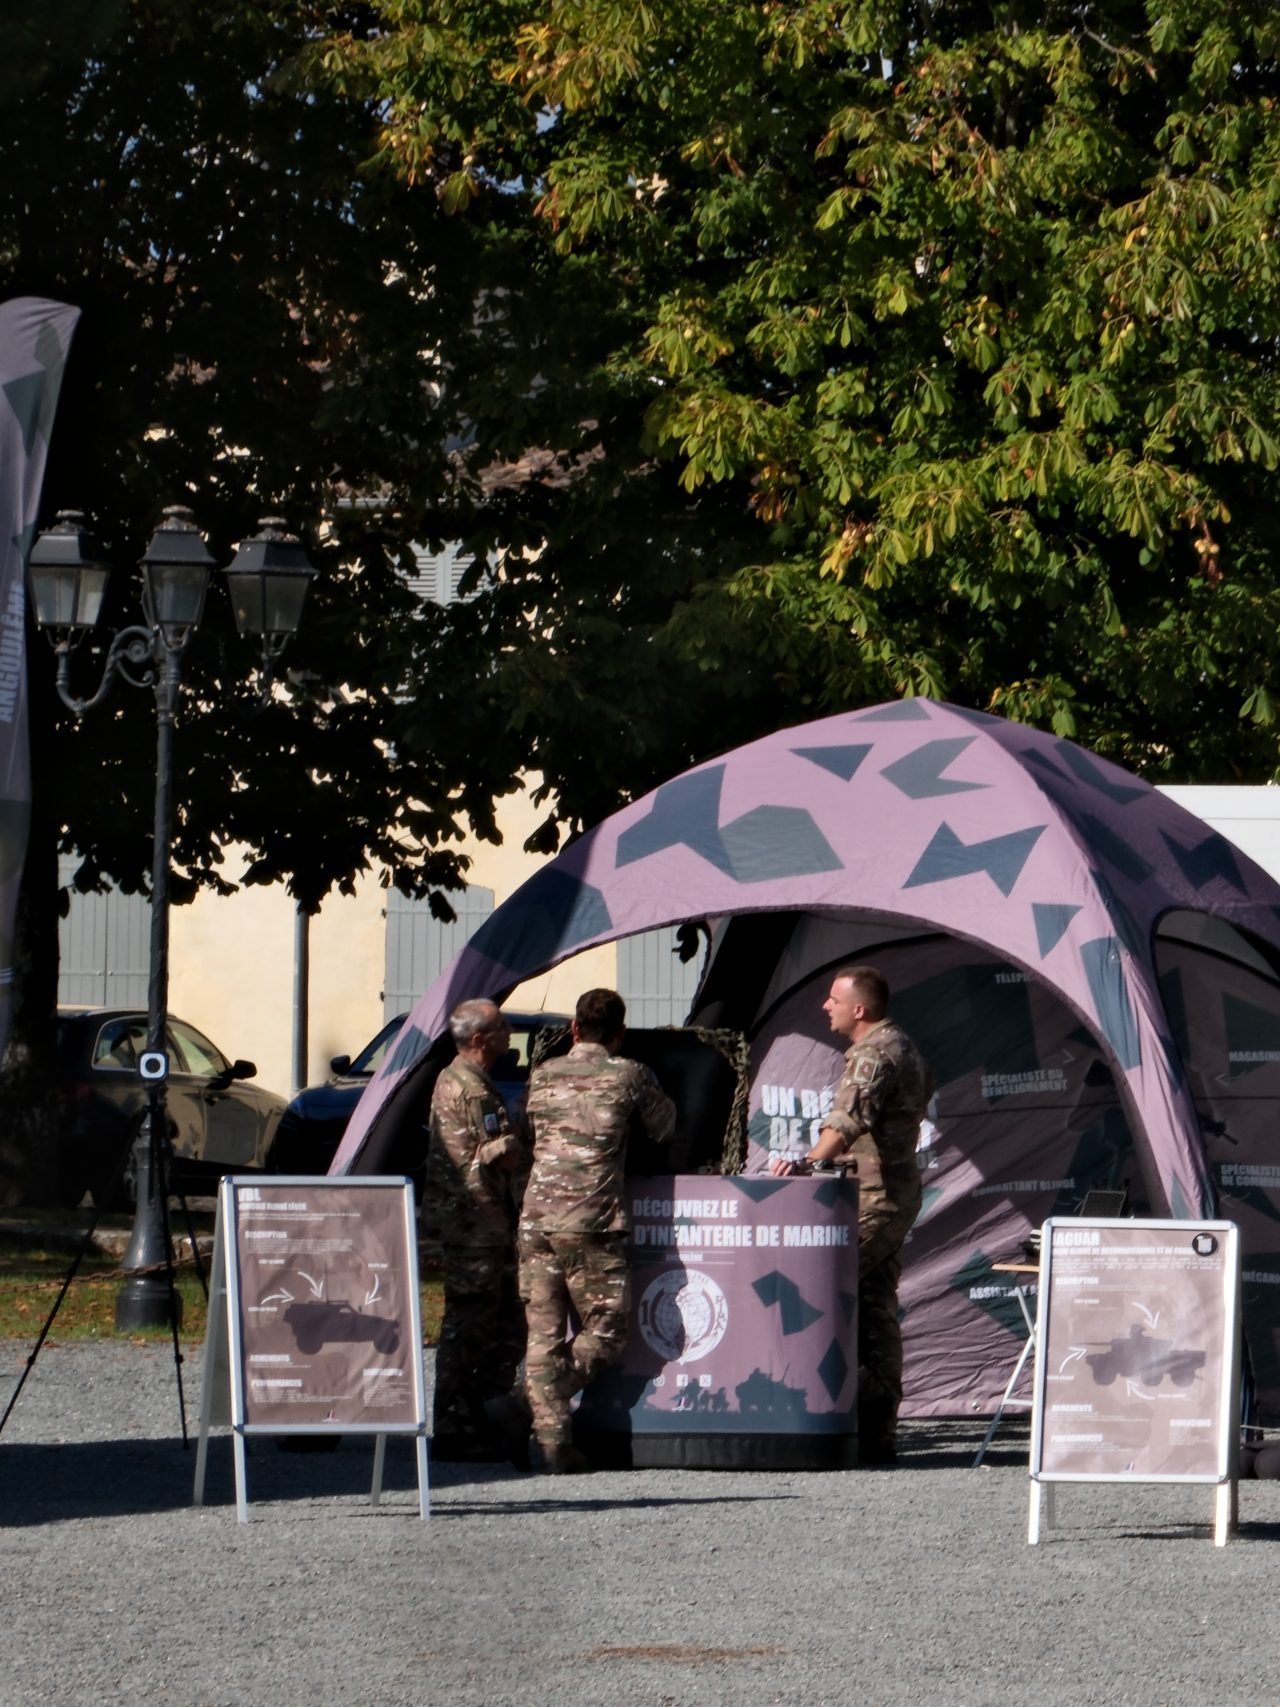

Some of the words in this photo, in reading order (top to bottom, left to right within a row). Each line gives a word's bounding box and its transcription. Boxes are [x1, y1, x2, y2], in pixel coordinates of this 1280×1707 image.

[981, 1069, 1045, 1088] SPÉCIALISTE
[762, 1084, 796, 1117] UN
[769, 1116, 802, 1151] DE
[1222, 1174, 1234, 1186] DE
[632, 1197, 719, 1218] DÉCOUVREZ
[721, 1199, 738, 1218] LE
[634, 1225, 752, 1247] D'INFANTERIE
[756, 1225, 779, 1247] DE
[783, 1225, 849, 1247] MARINE
